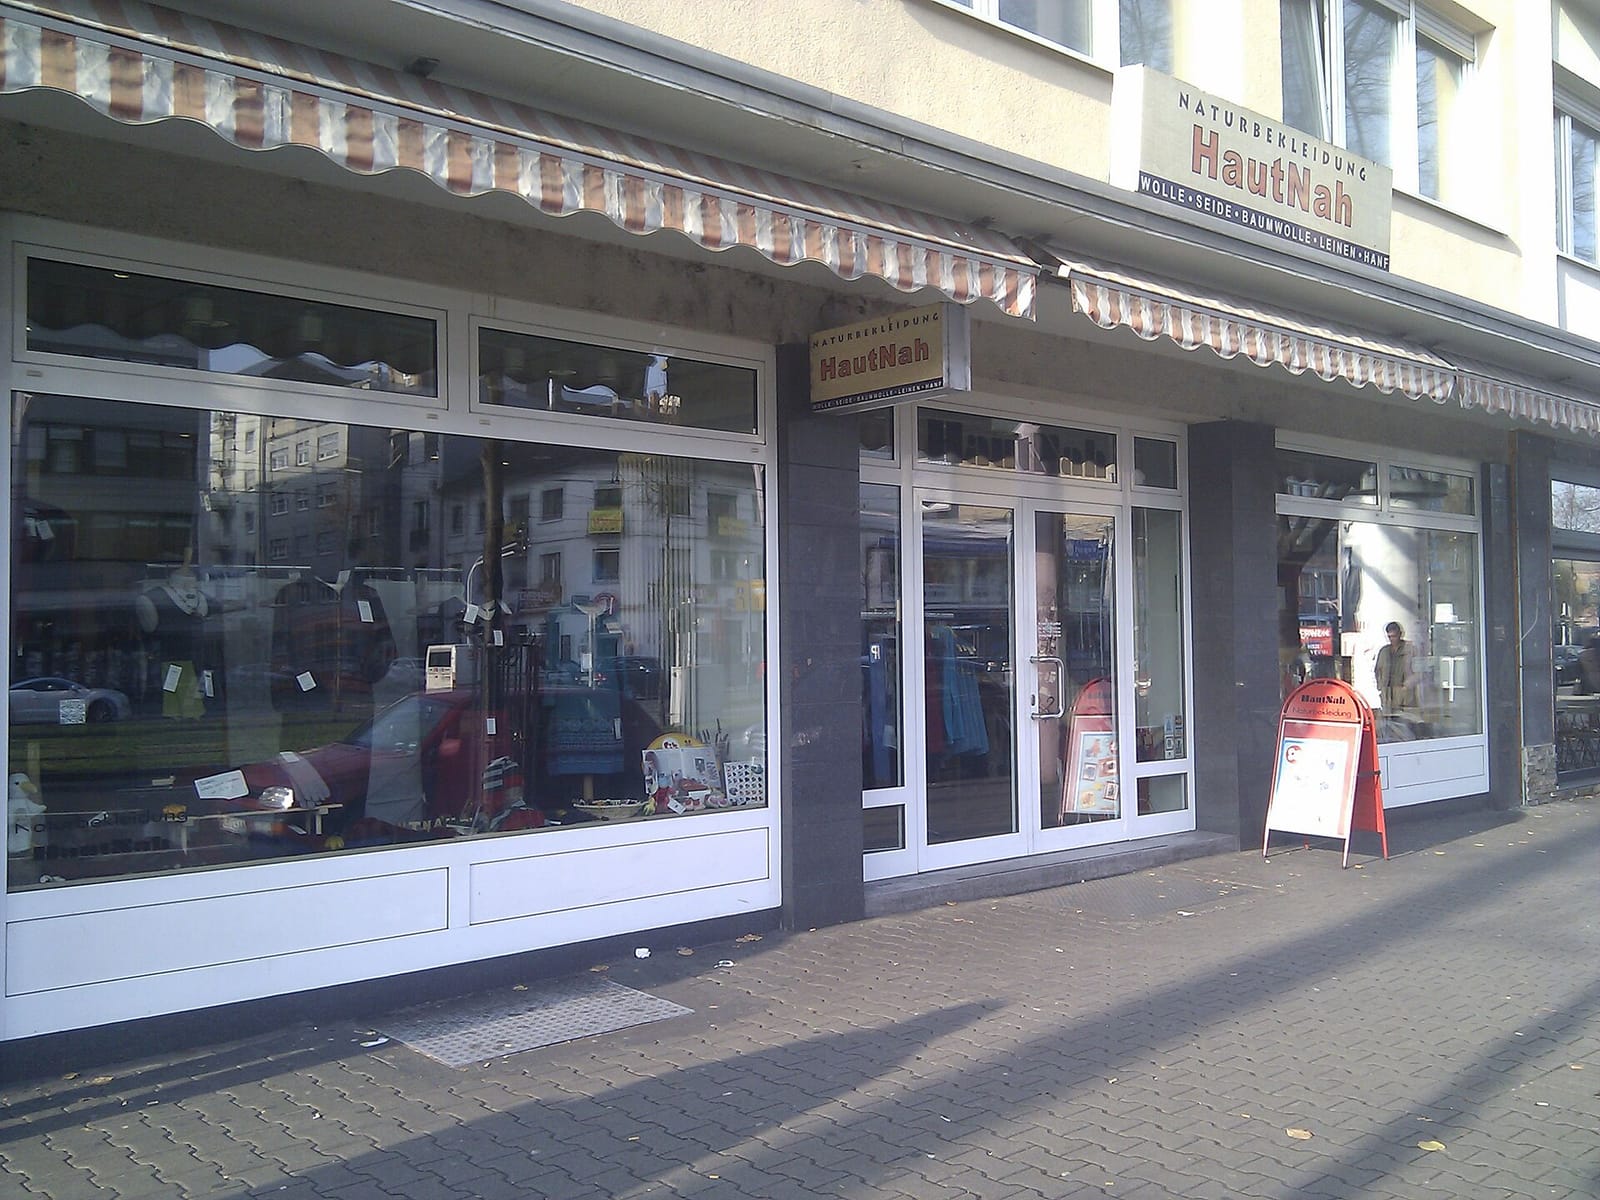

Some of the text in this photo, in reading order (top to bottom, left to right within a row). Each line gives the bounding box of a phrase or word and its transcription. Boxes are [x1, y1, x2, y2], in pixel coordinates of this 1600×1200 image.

[1178, 91, 1368, 182] NATURBEKLEIDUNG
[1191, 123, 1353, 228] HautNah
[1140, 175, 1389, 269] WOLLE SEIDE BAUMWOLLE LEINEN HANF
[812, 312, 940, 350] NATURBEKLEIDUNG
[820, 338, 929, 382] HautNah
[1300, 694, 1346, 705] HautNah
